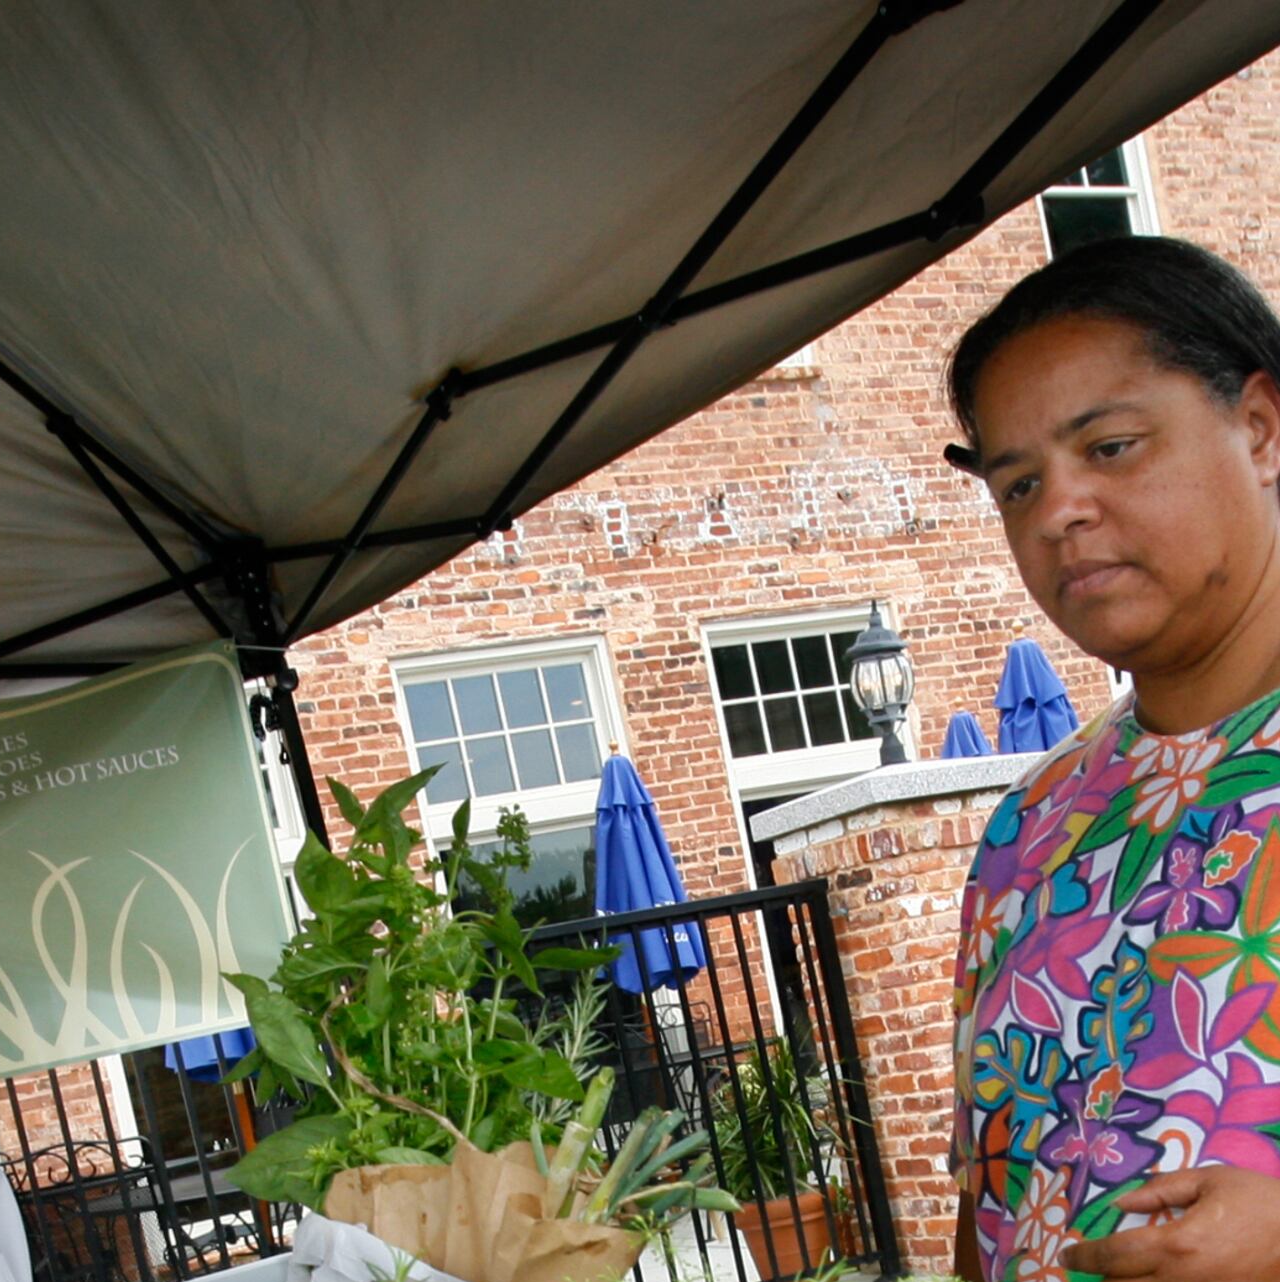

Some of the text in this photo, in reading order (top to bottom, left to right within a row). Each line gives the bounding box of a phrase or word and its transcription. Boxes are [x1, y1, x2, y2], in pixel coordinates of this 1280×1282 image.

[11, 779, 31, 797] &
[34, 763, 92, 791] HOT
[96, 745, 180, 781] SAUCES
